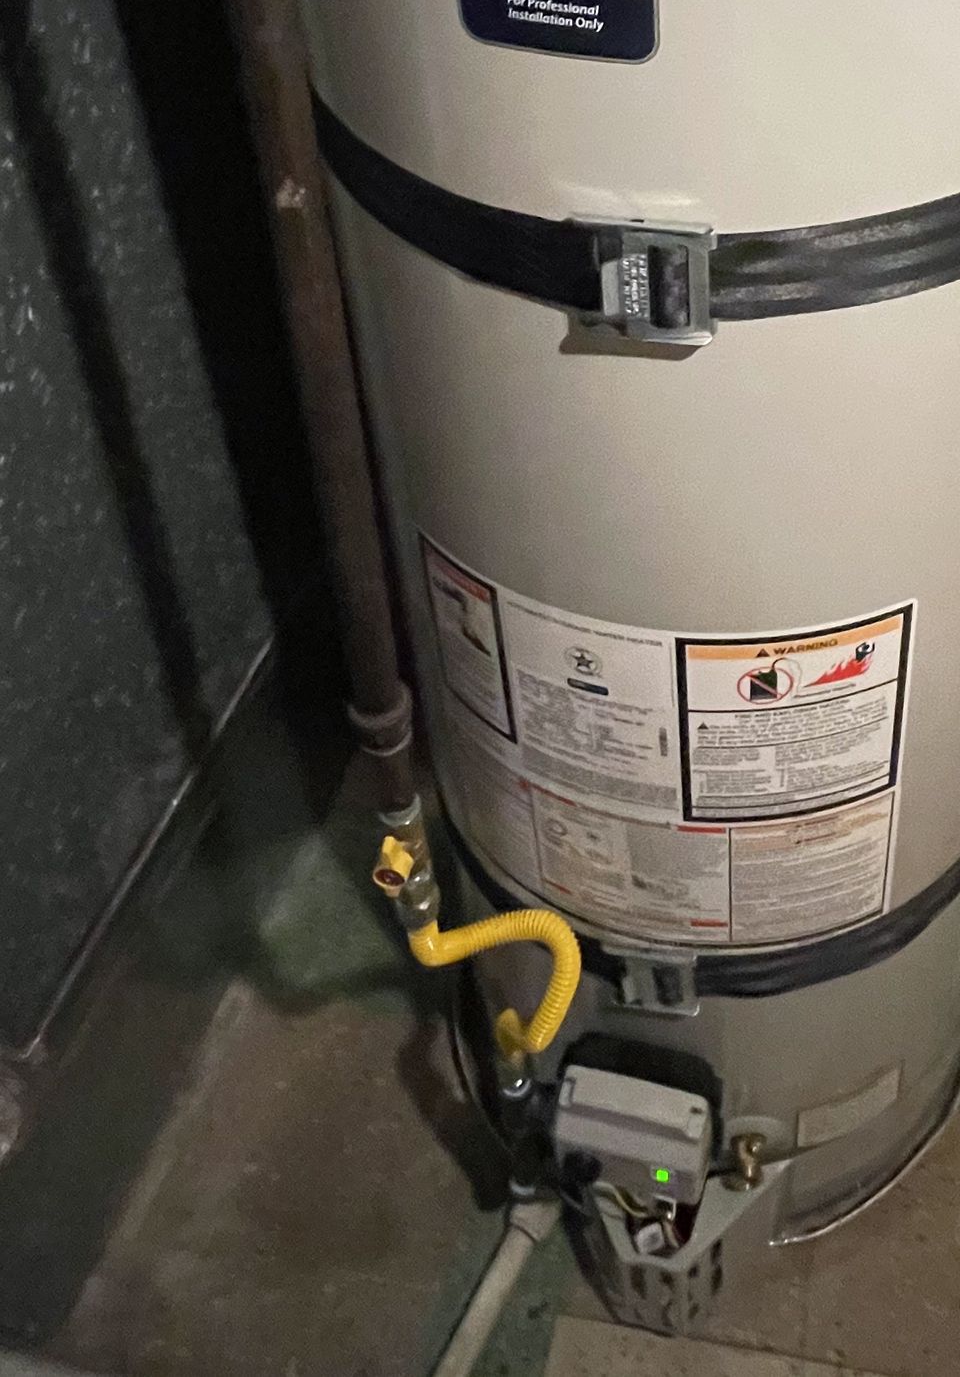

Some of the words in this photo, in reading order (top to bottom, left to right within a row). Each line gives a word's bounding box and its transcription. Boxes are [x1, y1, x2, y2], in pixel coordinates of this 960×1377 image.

[508, 8, 573, 27] Installation
[575, 17, 604, 33] Only
[773, 639, 839, 656] WARNING
